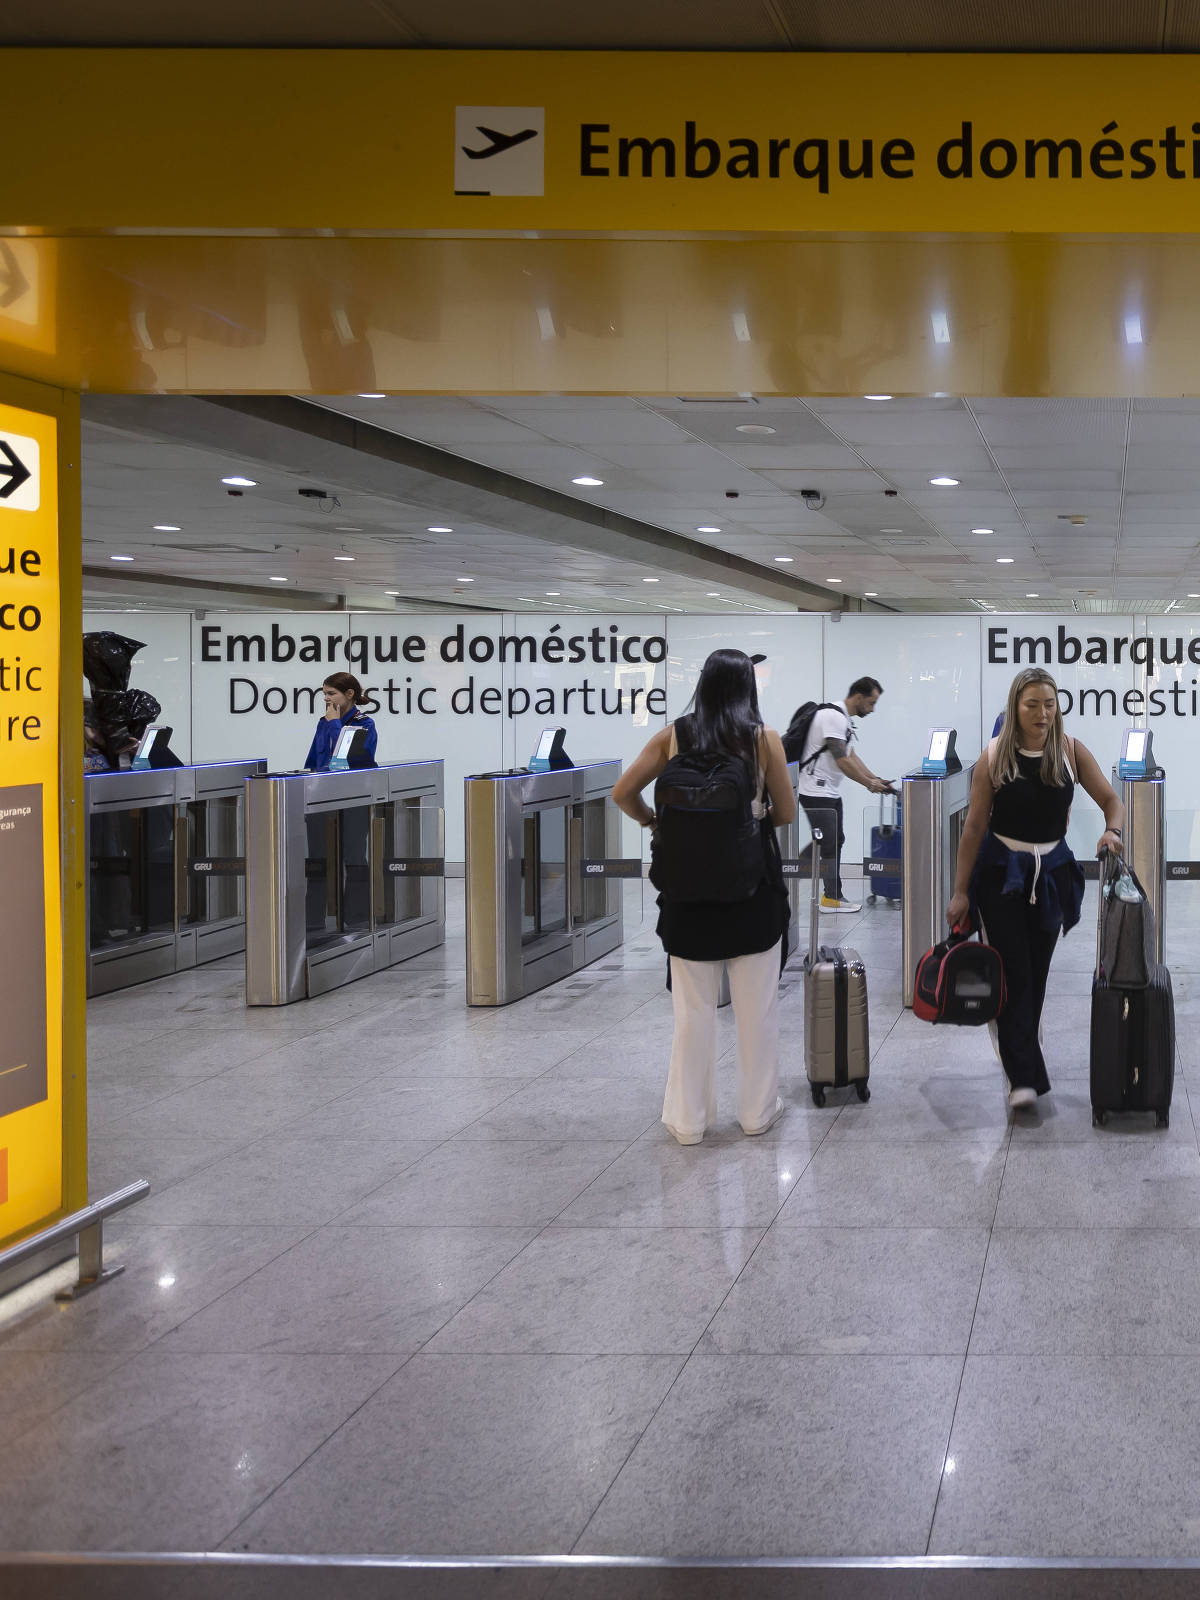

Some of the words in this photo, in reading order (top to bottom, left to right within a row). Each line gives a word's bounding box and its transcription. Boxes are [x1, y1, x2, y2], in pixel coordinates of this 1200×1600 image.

[580, 120, 916, 195] Embarque
[0, 603, 41, 632] co
[200, 623, 426, 675] Embarque
[440, 623, 668, 665] doméstico
[0, 656, 41, 692] tic
[230, 676, 437, 716] Domstic
[451, 676, 667, 720] departure
